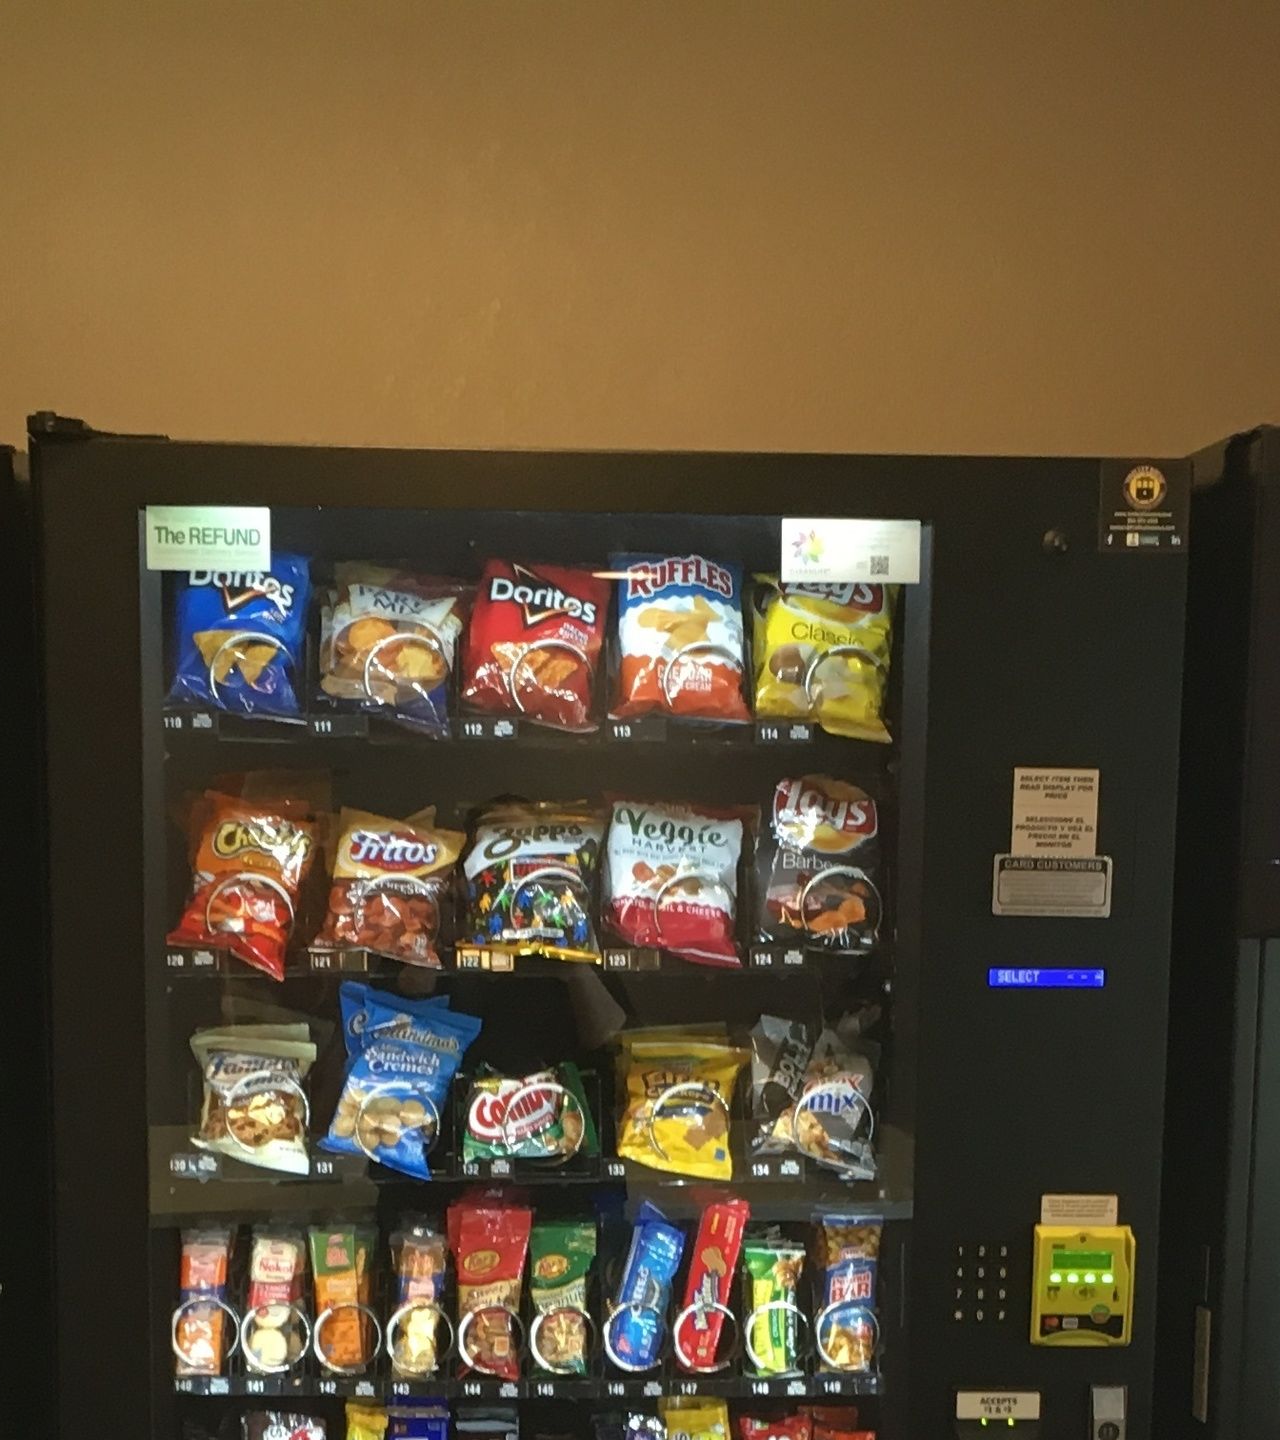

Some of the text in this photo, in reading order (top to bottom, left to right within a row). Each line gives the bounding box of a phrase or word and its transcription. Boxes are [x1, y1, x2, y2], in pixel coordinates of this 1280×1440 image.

[155, 527, 261, 546] The REFUND
[627, 553, 733, 599] RUFFLES
[491, 577, 596, 625] Doritos
[164, 716, 181, 728] 110
[314, 721, 331, 732] 111
[464, 724, 482, 735] 112
[760, 727, 778, 739] 114
[614, 808, 728, 848] Veggie
[349, 829, 438, 864] Fritos
[632, 837, 709, 854] HARVEST
[1004, 859, 1103, 871] CARD CUSTOMERS
[167, 954, 184, 966] 120
[463, 955, 479, 968] 122
[608, 954, 626, 967] 123
[754, 954, 772, 966] 124
[997, 970, 1041, 984] SELECT
[365, 1047, 440, 1069] Sandwich
[370, 1059, 435, 1075] Cremes
[806, 1091, 857, 1114] mix
[316, 1162, 333, 1174] 131
[463, 1163, 479, 1176] 132
[608, 1164, 625, 1176] 133
[752, 1164, 769, 1176] 134
[247, 1381, 265, 1393] 141
[320, 1382, 337, 1395] 142
[464, 1383, 481, 1395] 144
[681, 1382, 698, 1395] 147
[824, 1382, 841, 1394] 149
